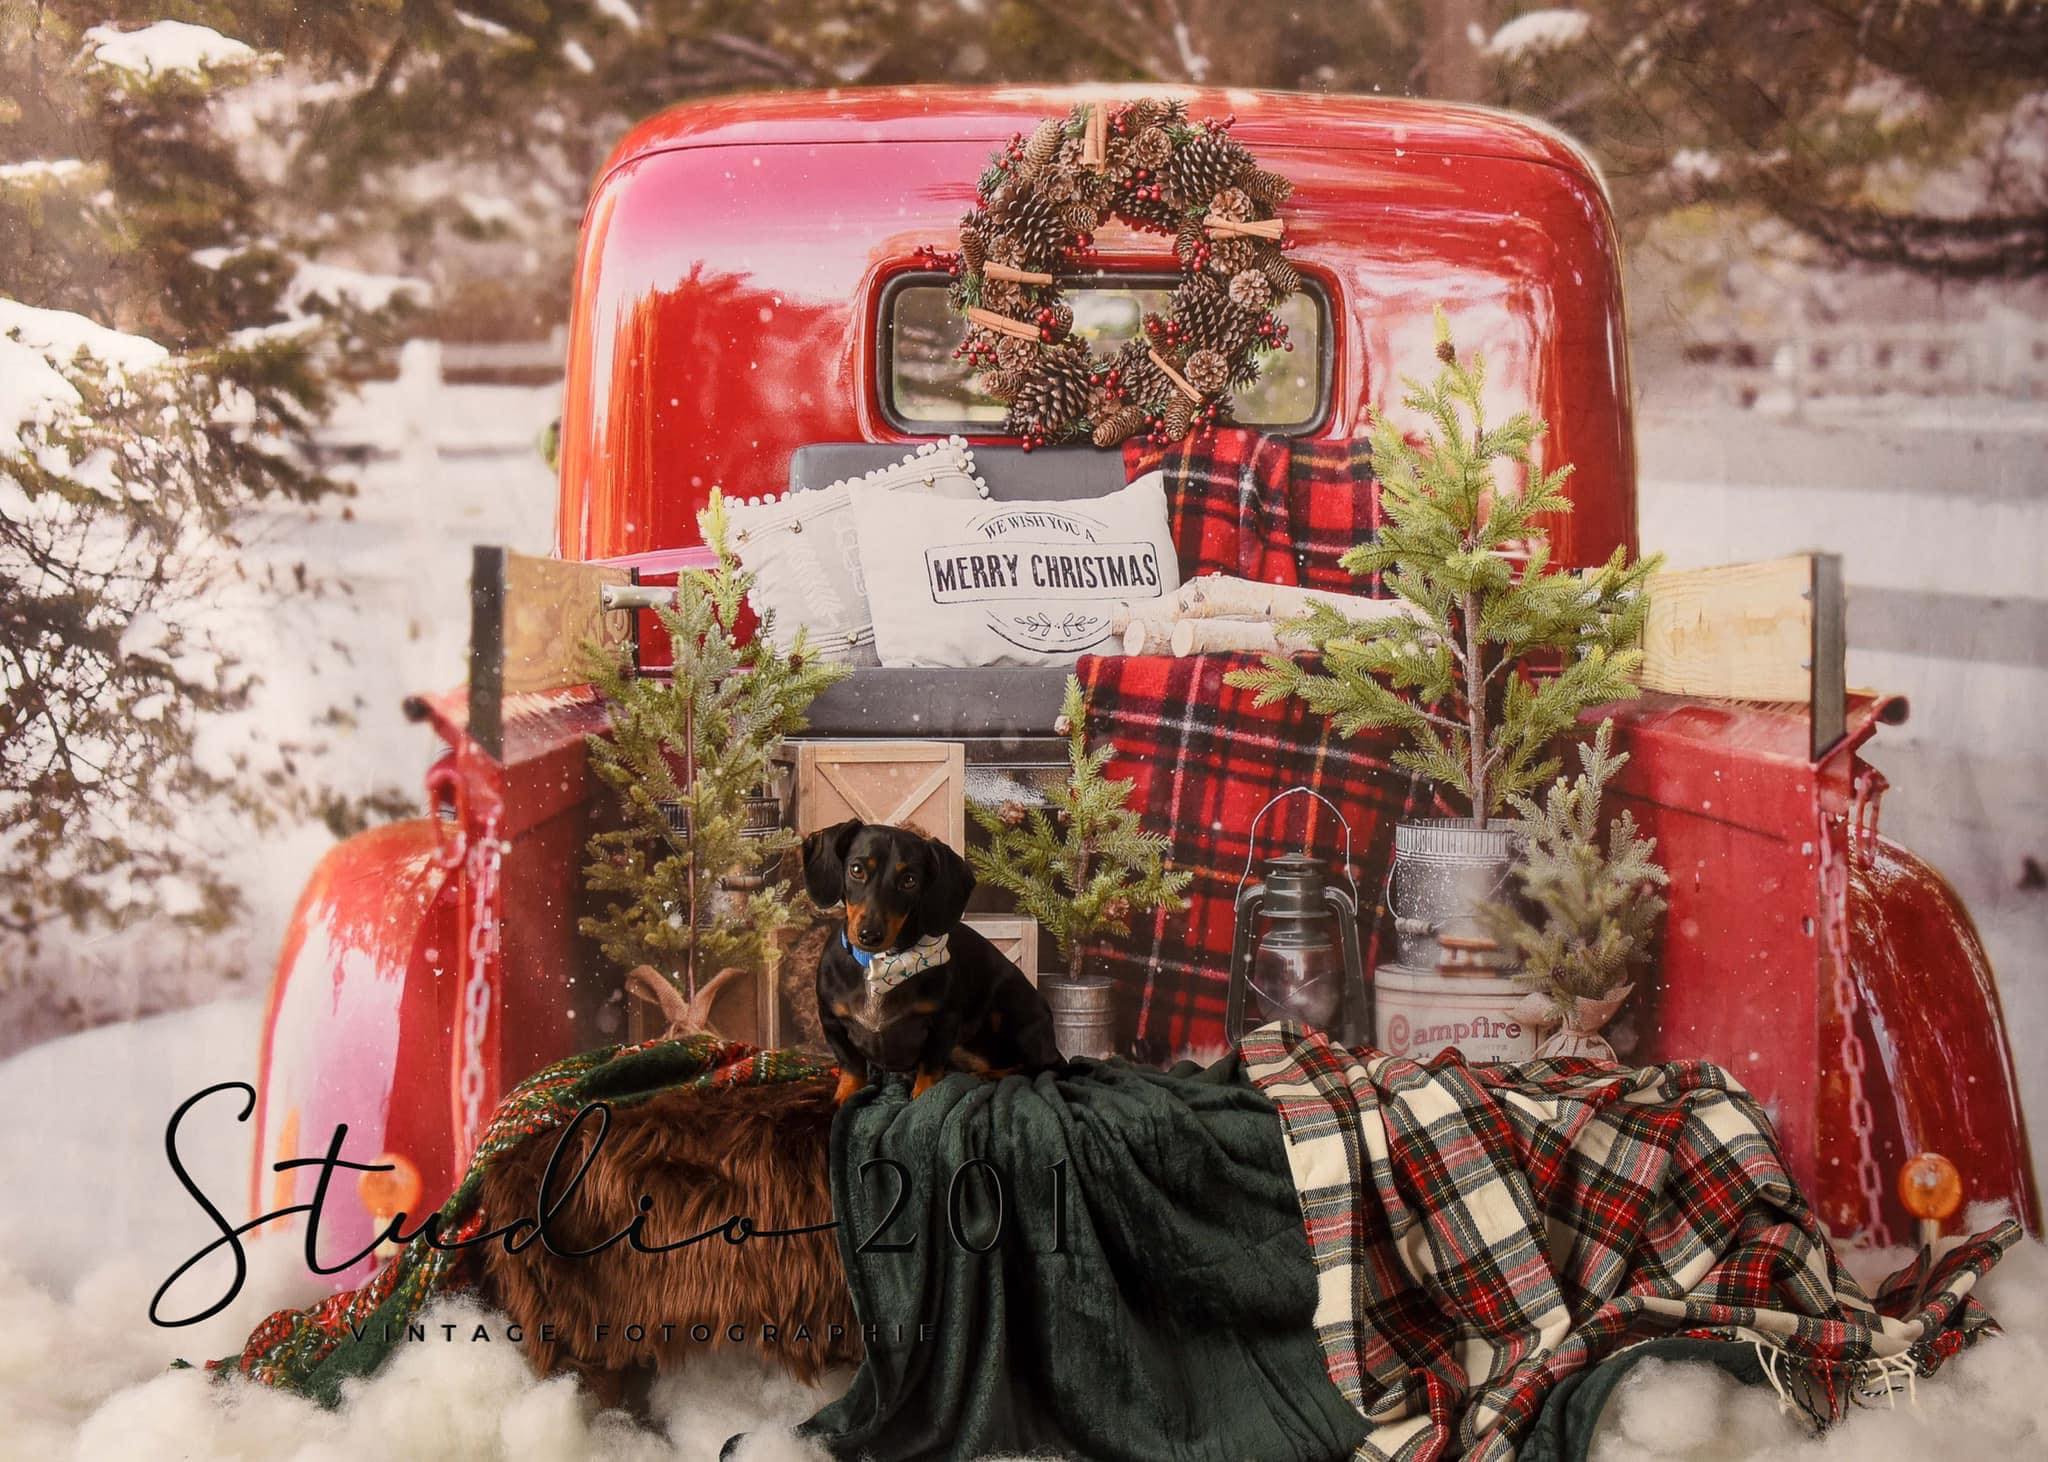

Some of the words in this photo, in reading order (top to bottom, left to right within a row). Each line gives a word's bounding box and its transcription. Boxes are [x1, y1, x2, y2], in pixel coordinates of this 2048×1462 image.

[984, 519, 1007, 540] WE
[1007, 515, 1046, 529] WISH
[1047, 516, 1081, 537] YOU
[1085, 528, 1098, 544] A
[933, 553, 1019, 592] MERRY
[1031, 553, 1157, 589] CHRISTMAS
[1387, 1013, 1522, 1057] Campfire
